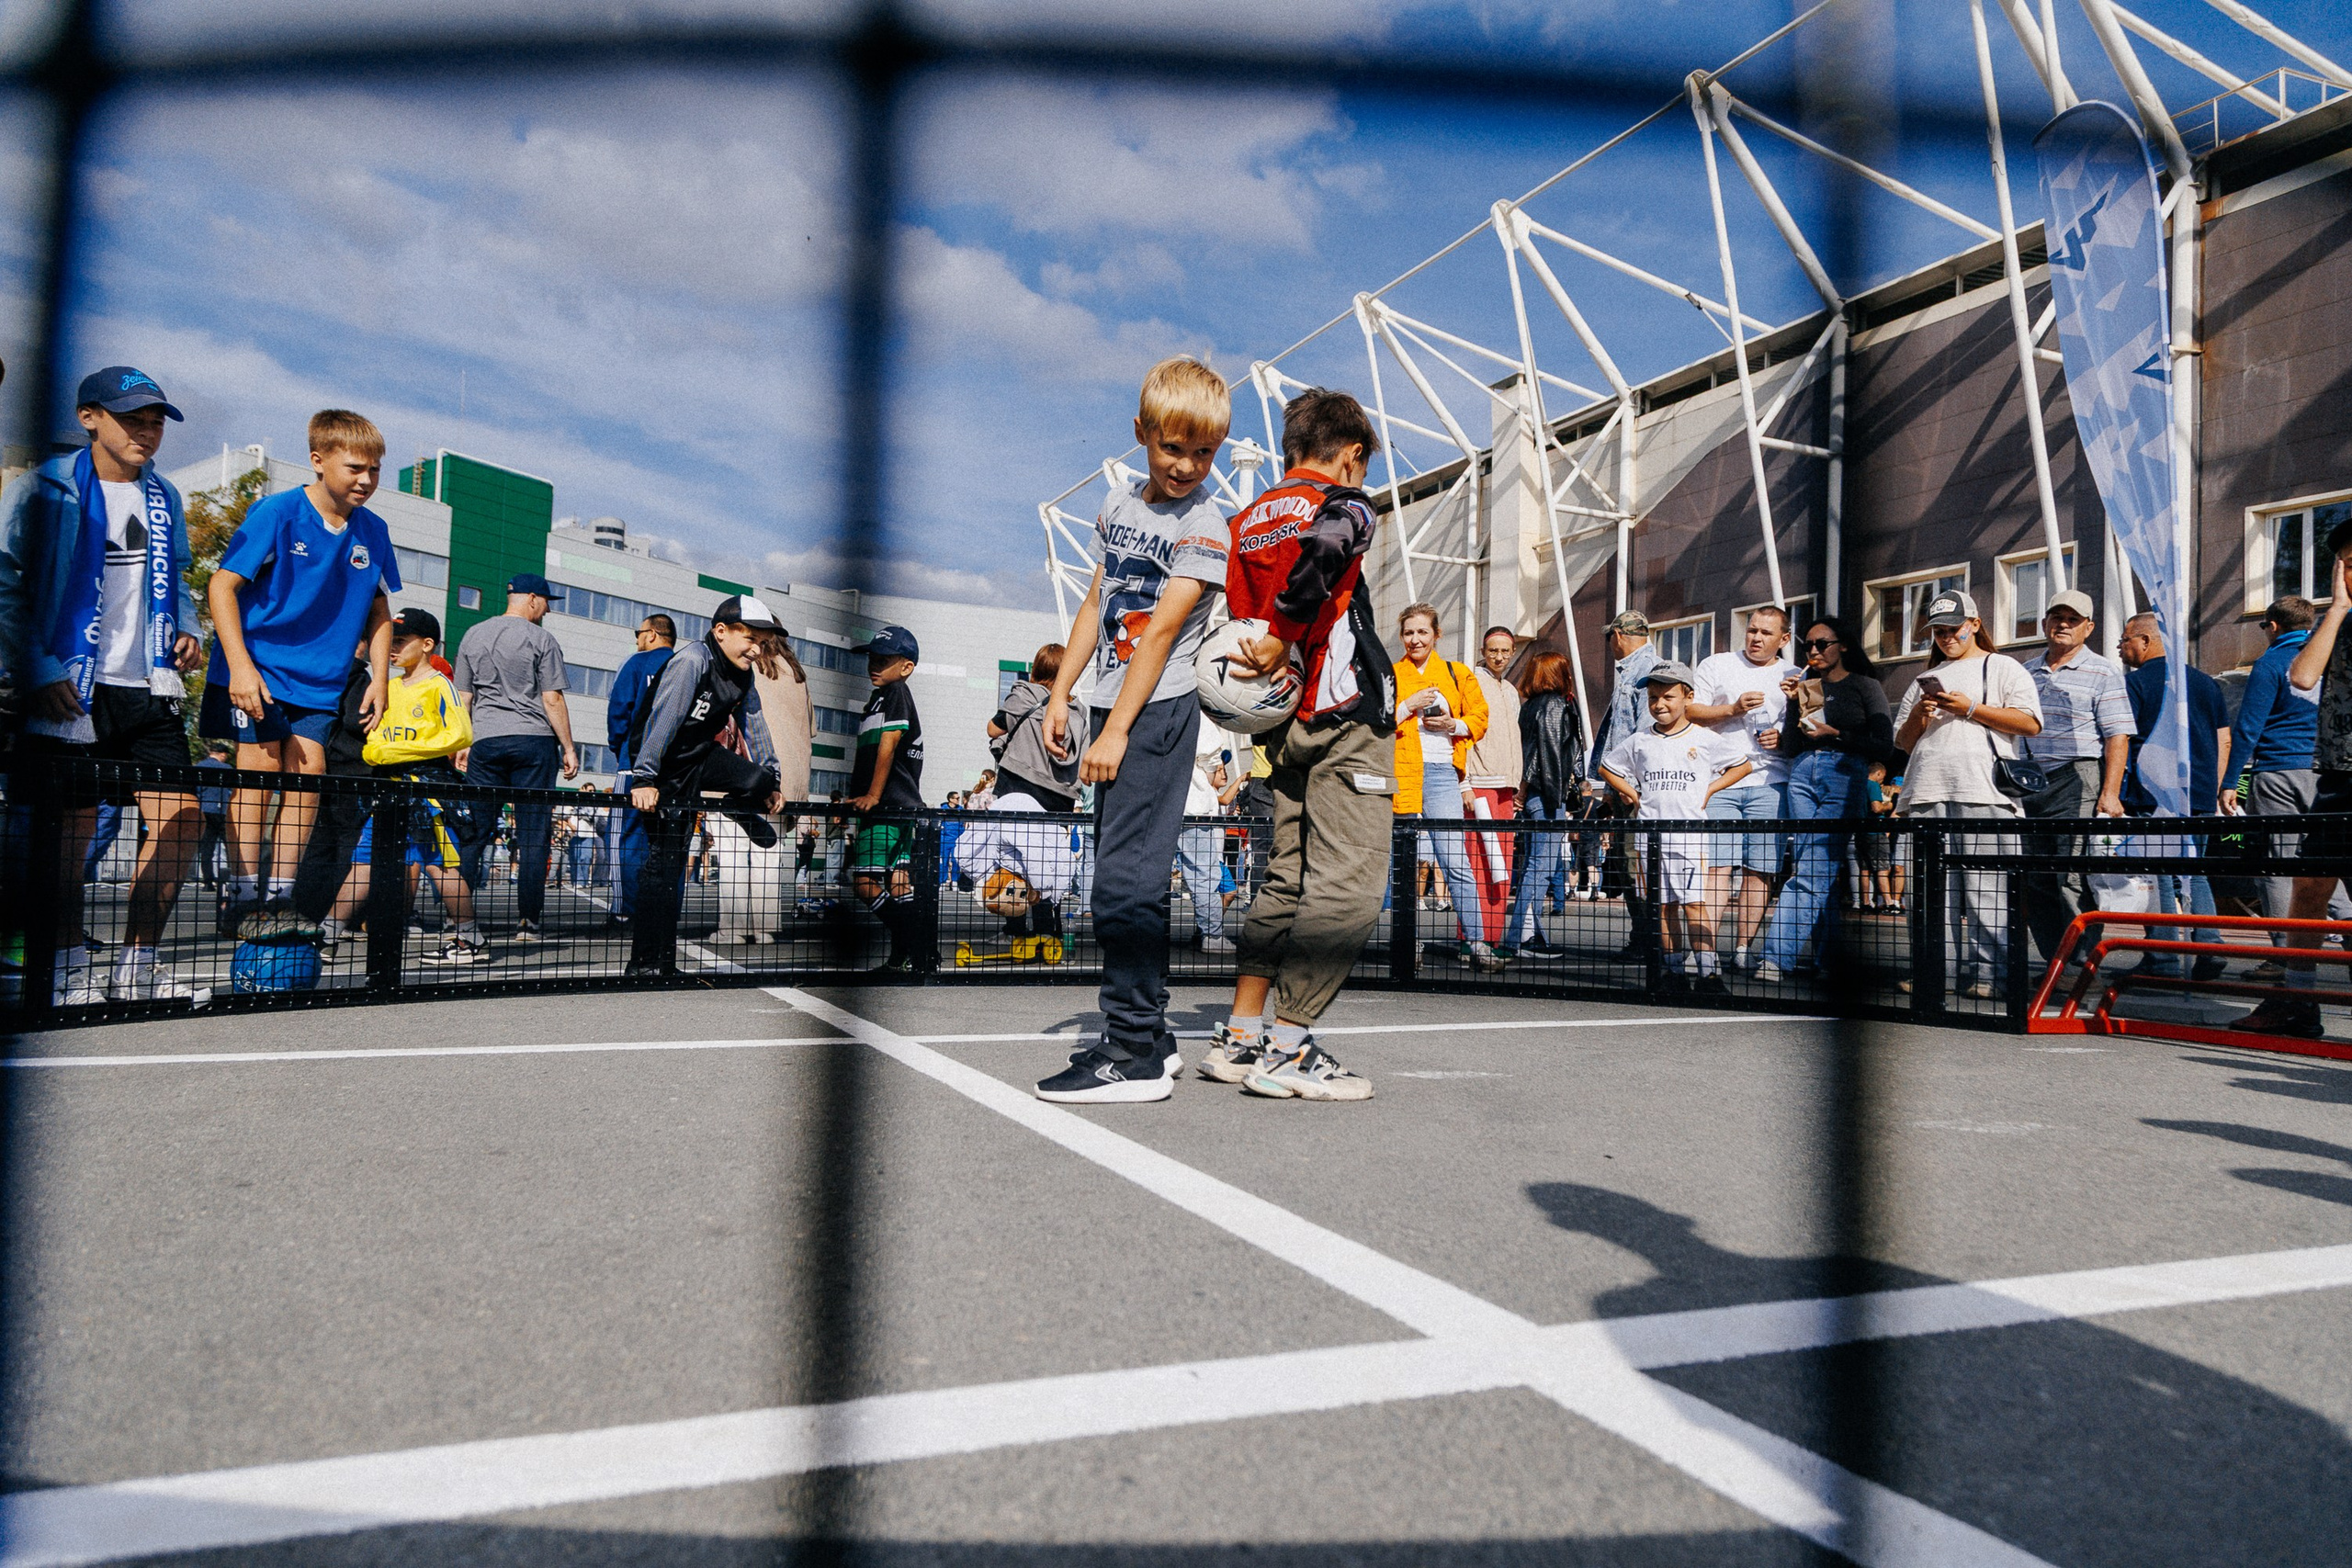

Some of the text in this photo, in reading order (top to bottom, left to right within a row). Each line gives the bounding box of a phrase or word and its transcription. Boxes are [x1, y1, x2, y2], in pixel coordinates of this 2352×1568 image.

[82, 657, 95, 700] ЕЛЯБИНСК
[231, 707, 248, 728] 19
[691, 699, 711, 721] 12
[1644, 768, 1696, 783] Emirates
[1661, 781, 1688, 792] BETTER
[1682, 867, 1695, 890] 7
